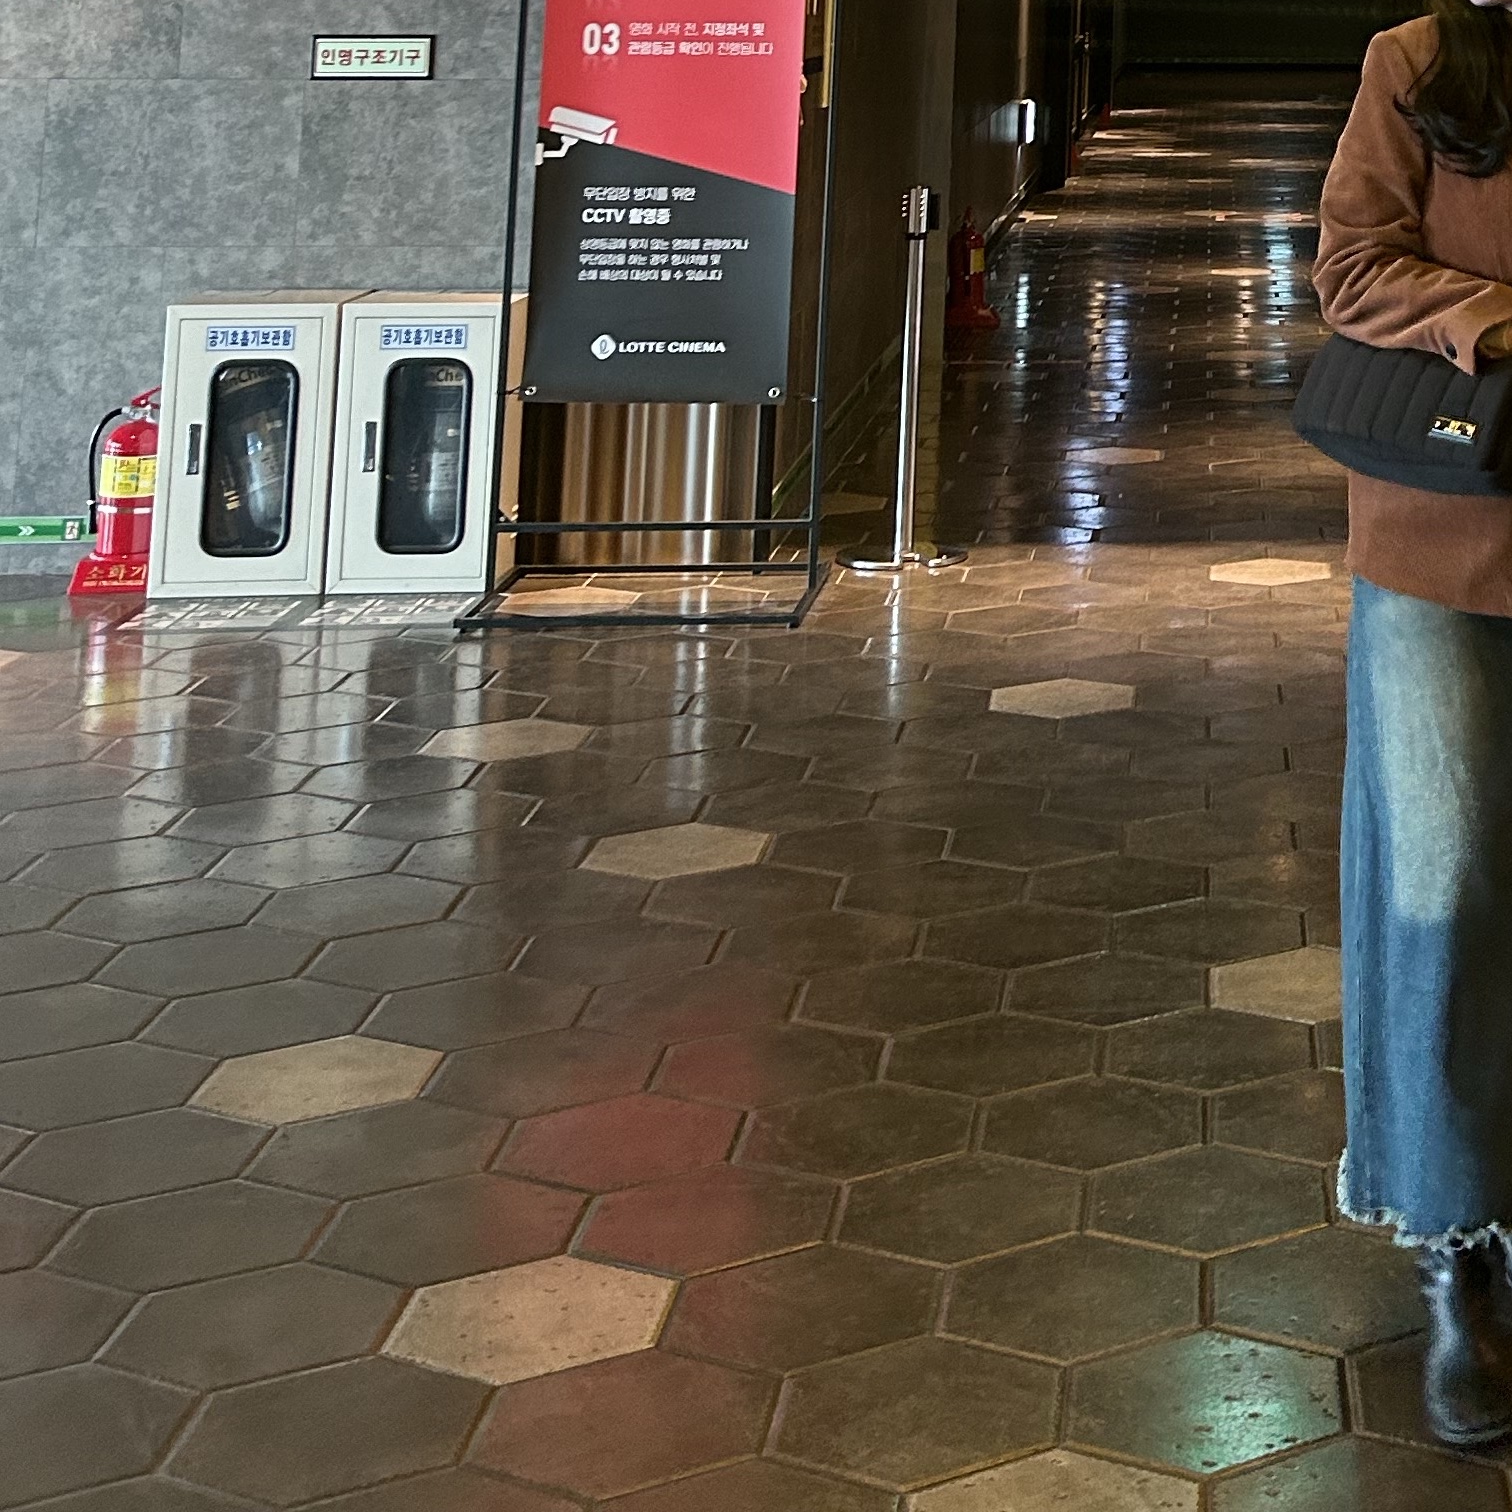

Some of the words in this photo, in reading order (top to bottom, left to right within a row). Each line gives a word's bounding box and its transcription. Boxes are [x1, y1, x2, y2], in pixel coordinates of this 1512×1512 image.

[656, 22, 680, 36] 시작
[702, 22, 749, 37] 지정좌석
[752, 22, 765, 37] 및
[583, 22, 621, 55] 03
[678, 41, 714, 55] 확인이
[321, 49, 421, 66] 인명구조기구
[581, 208, 626, 223] CCTV
[208, 330, 292, 347] 공기호흡기보관함
[382, 328, 464, 345] 공기호흡기보관함
[619, 341, 666, 353] LOTTE
[667, 341, 726, 353] CINEMA
[86, 563, 147, 580] 소화기
